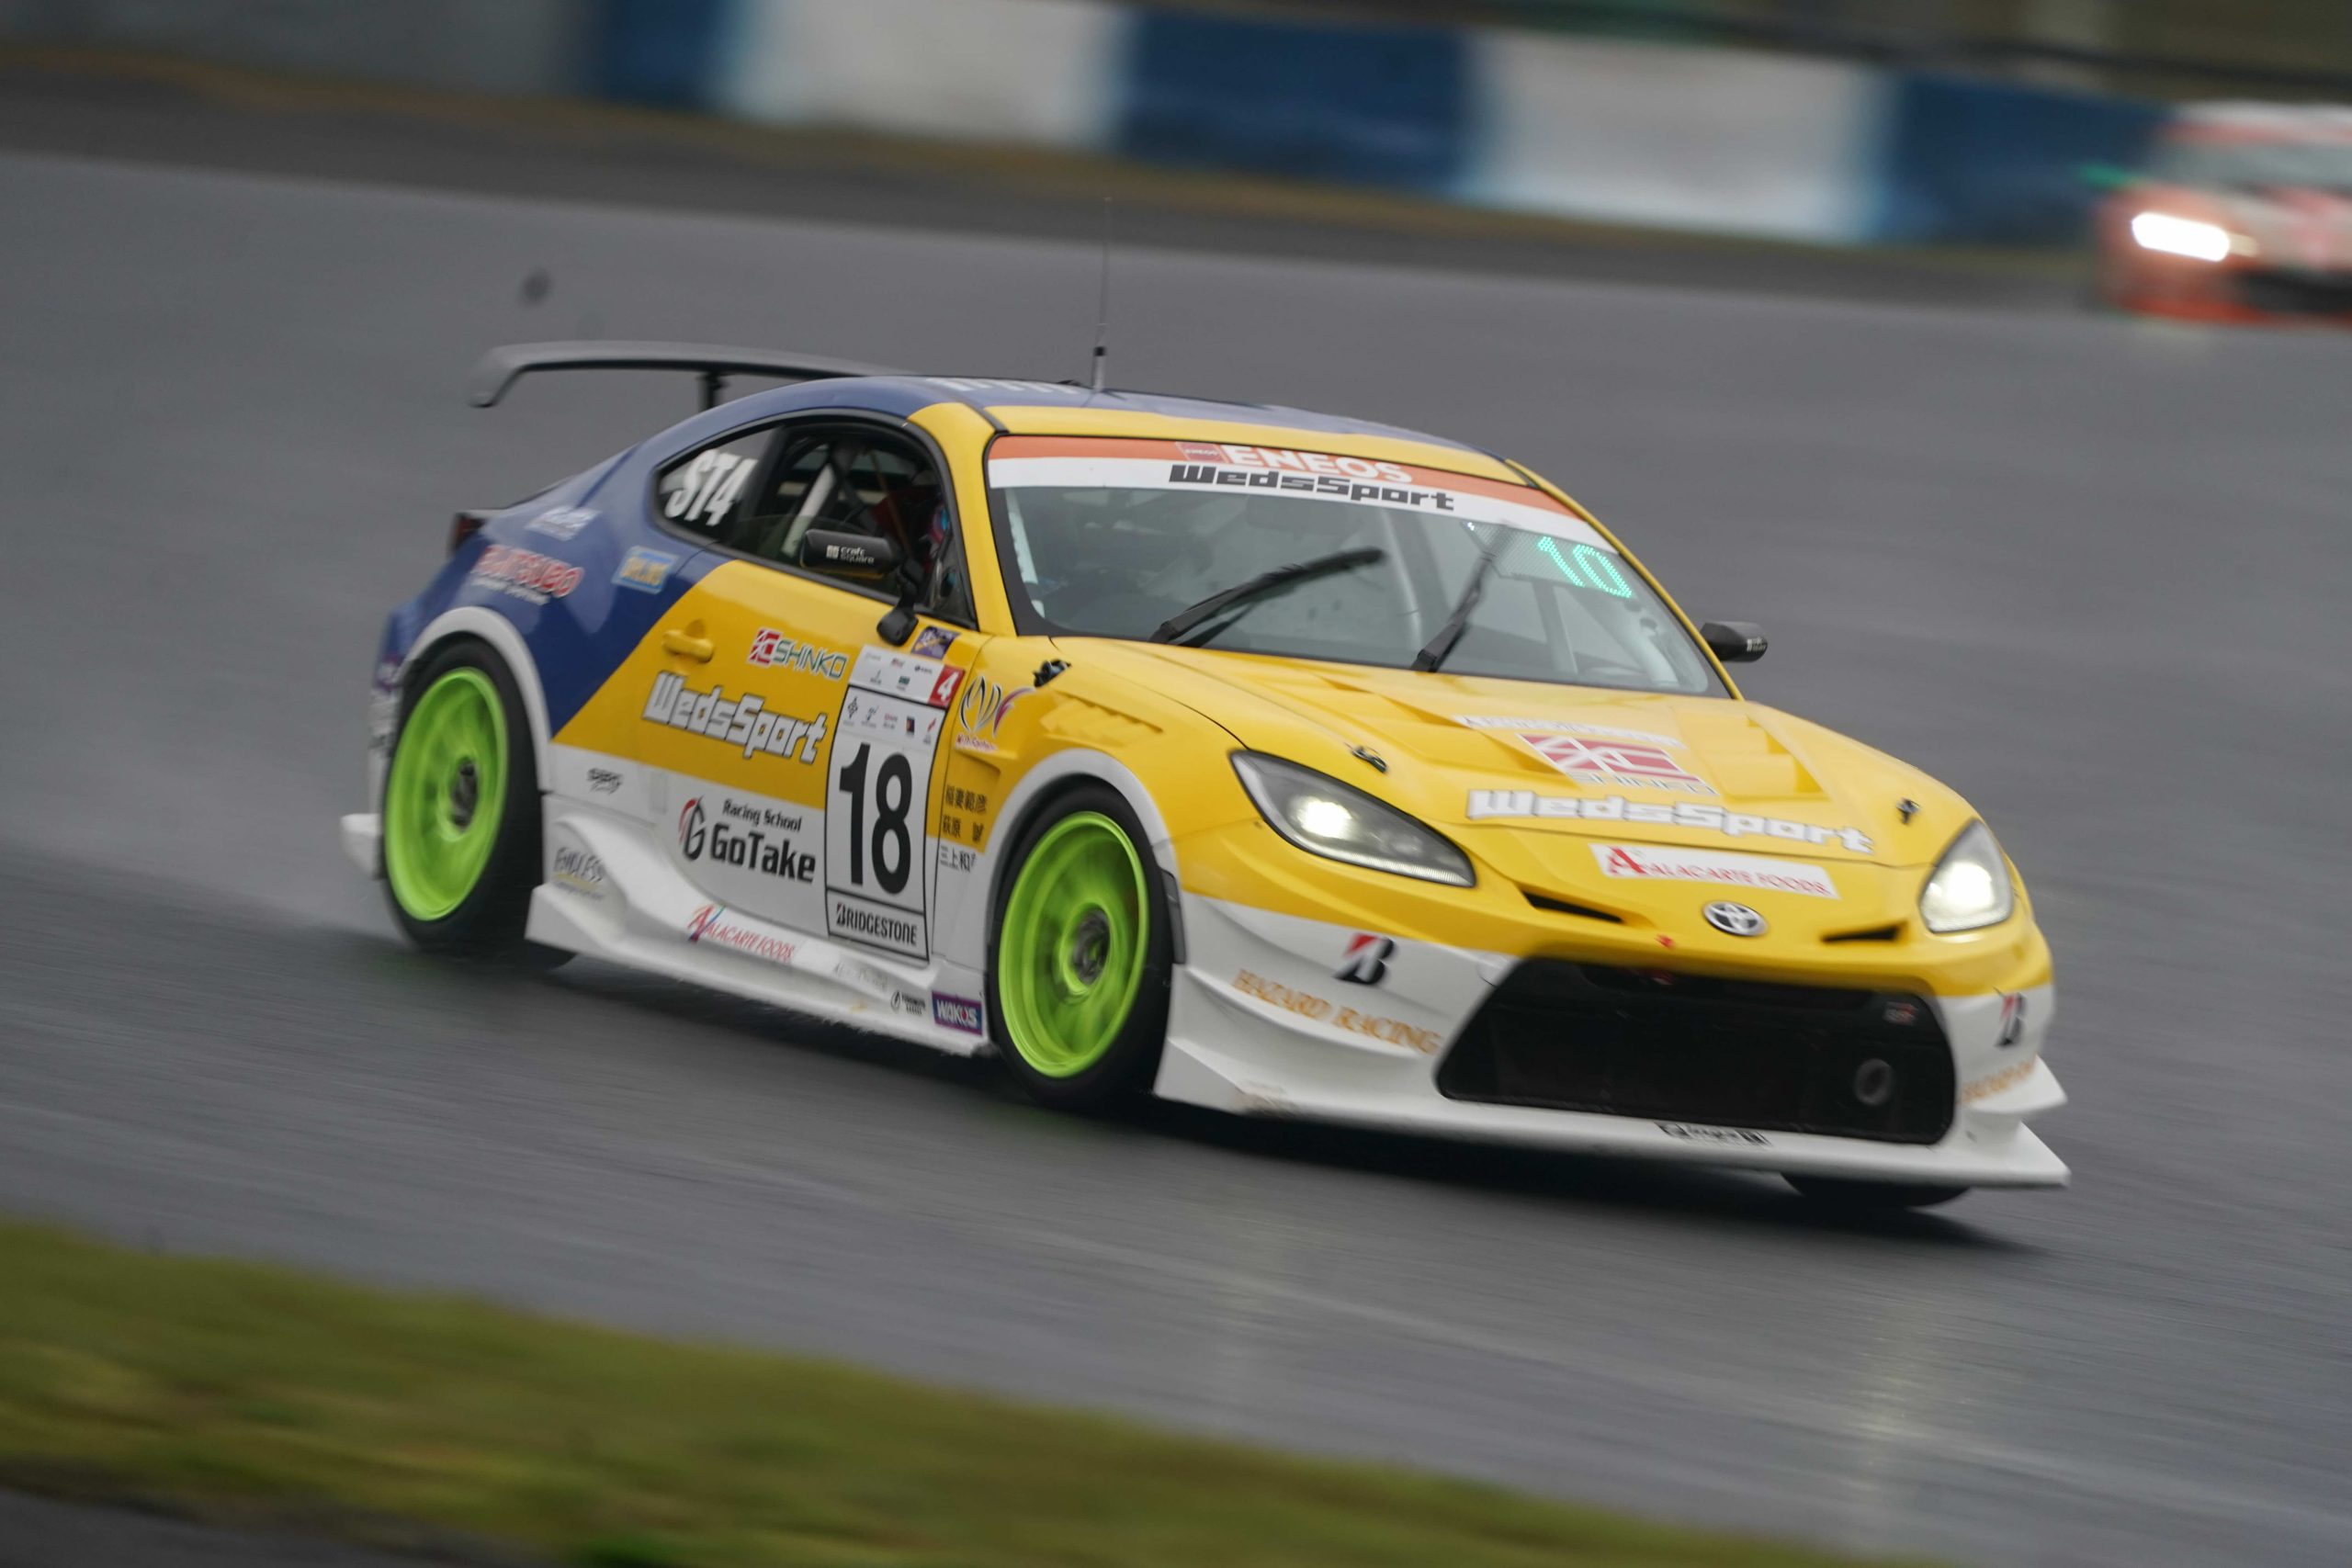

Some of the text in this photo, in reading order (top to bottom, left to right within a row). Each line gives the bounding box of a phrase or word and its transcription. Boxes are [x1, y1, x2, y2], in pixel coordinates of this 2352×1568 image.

[664, 448, 759, 527] ST4
[1169, 465, 1455, 512] WedsSport
[1221, 445, 1413, 483] ENEOS
[1538, 536, 1633, 599] 10
[773, 640, 848, 680] SHINKO
[936, 670, 959, 703] 4
[642, 671, 828, 764] WedsSport
[722, 798, 803, 833] Racing School
[839, 742, 913, 896] 18
[1466, 789, 1874, 855] WedsSport
[710, 822, 816, 884] GoTake
[836, 901, 918, 946] BRIDGESTONE
